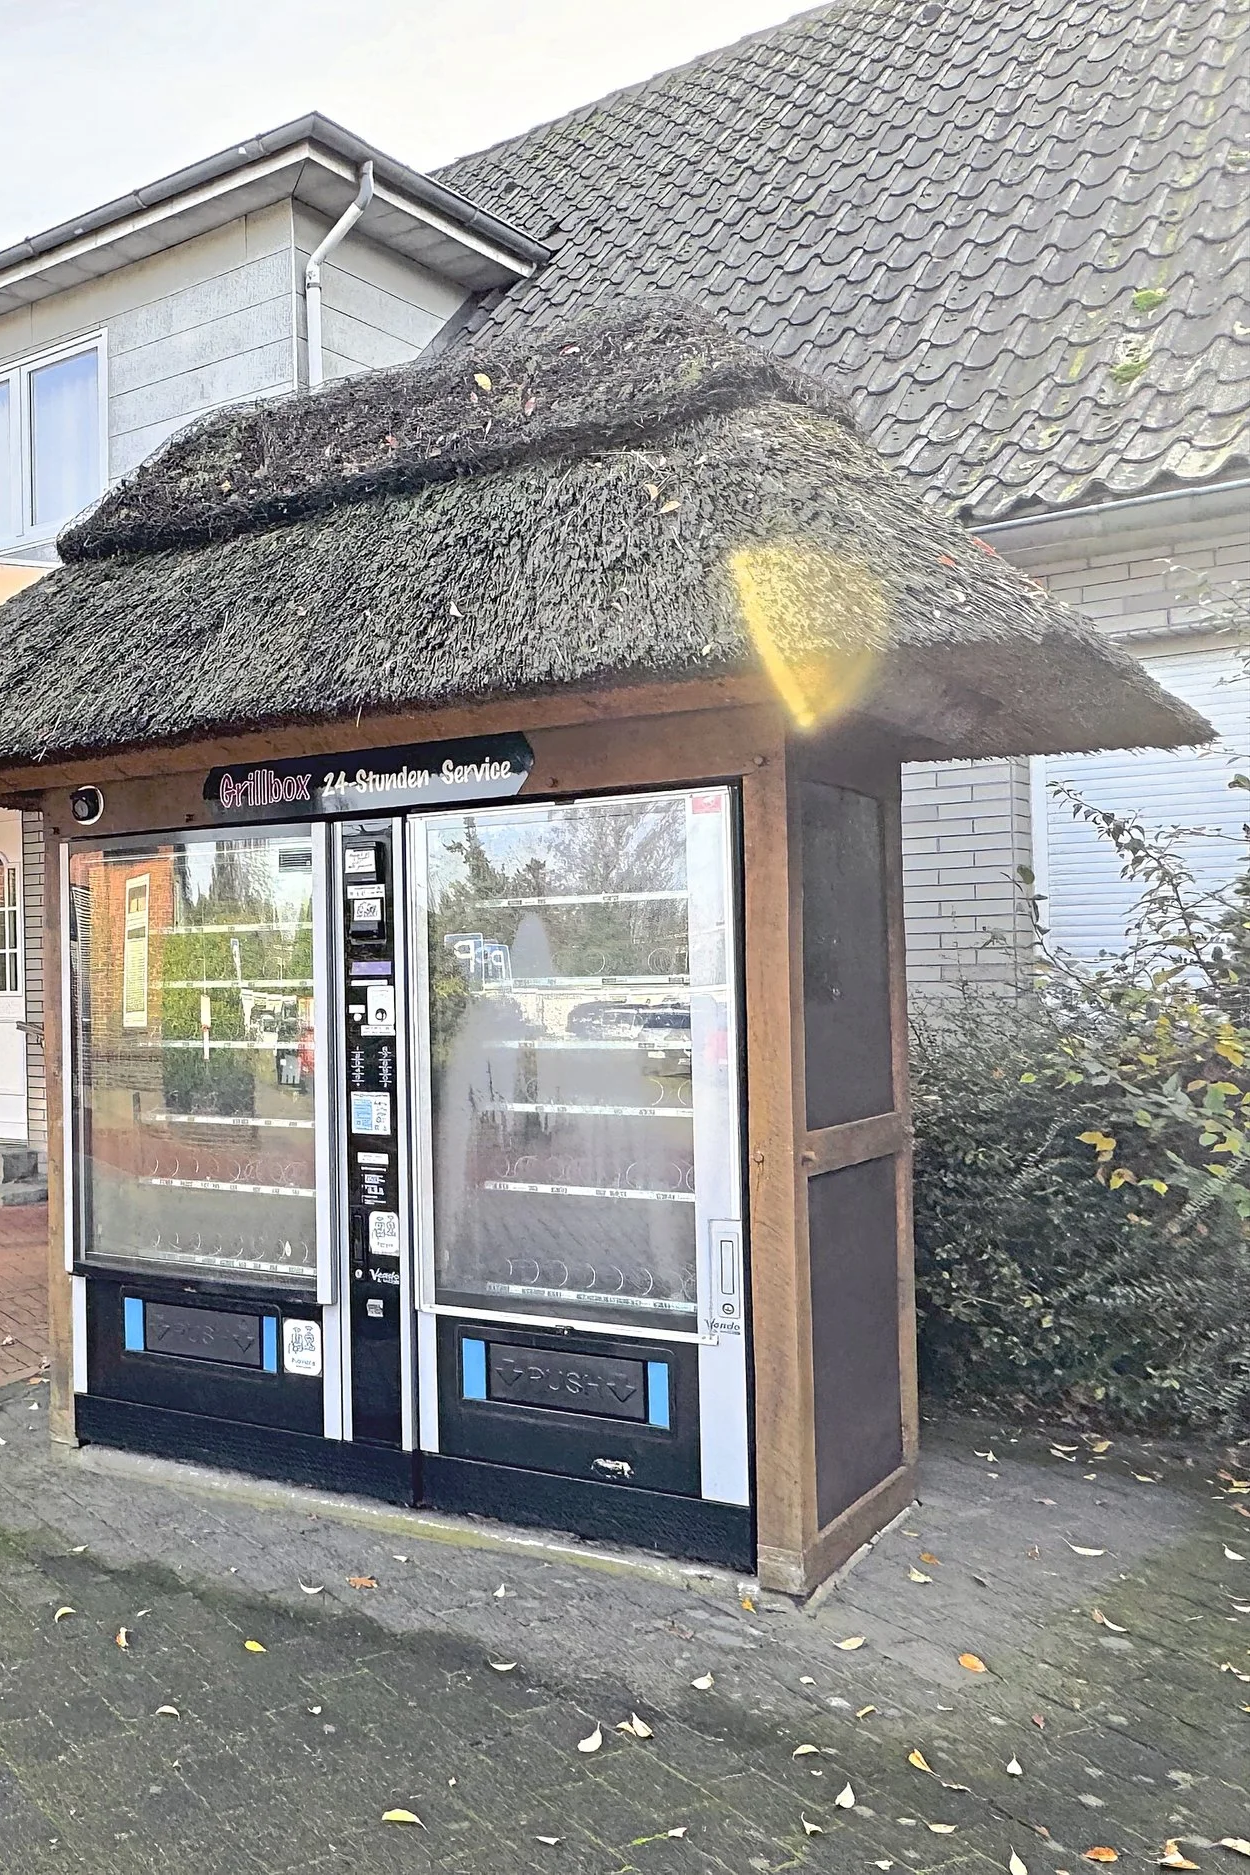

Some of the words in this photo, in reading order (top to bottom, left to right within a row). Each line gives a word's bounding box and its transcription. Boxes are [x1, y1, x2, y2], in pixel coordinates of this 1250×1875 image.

[219, 769, 312, 808] Grillbox
[321, 766, 430, 797] 24-Stunden
[441, 756, 511, 785] Service
